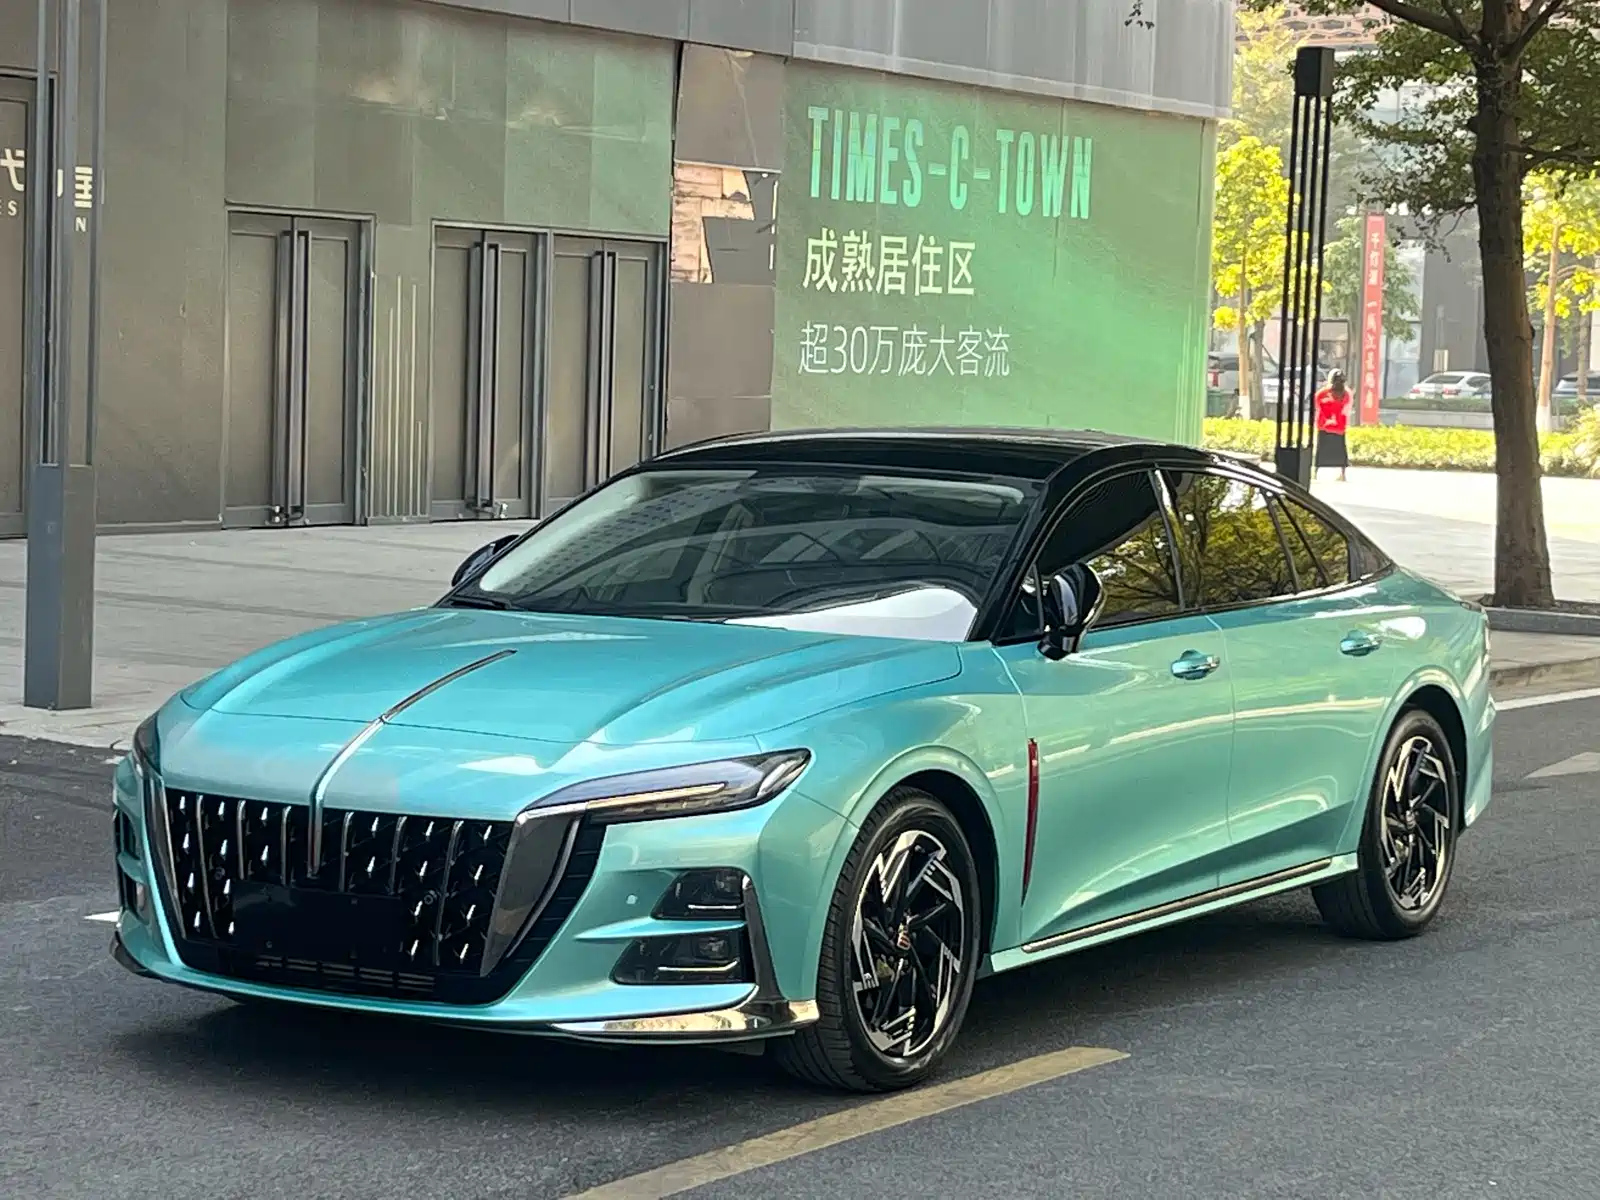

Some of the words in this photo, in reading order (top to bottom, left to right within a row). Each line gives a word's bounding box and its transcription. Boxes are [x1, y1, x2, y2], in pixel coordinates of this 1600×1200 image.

[807, 106, 1093, 220] TIMES-C-TOWN
[802, 227, 976, 297] 成熟居住区
[798, 320, 1010, 377] 超30万庞大客流
